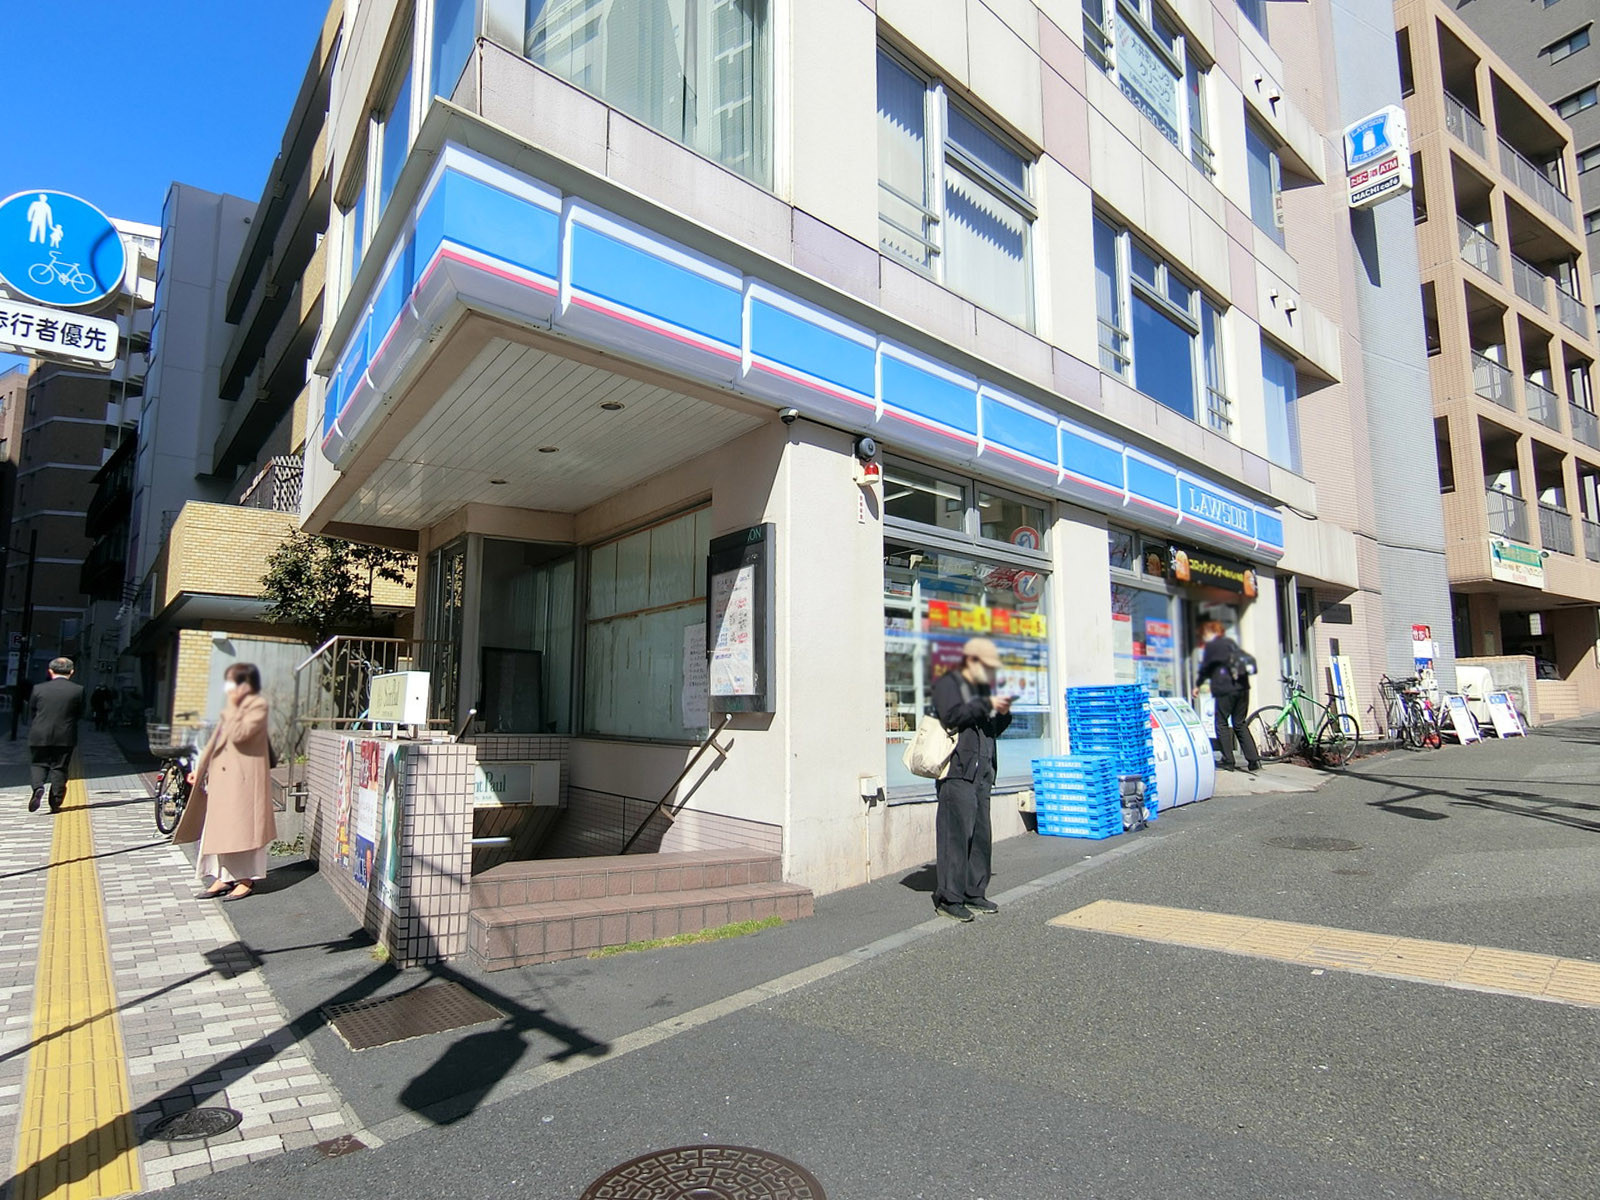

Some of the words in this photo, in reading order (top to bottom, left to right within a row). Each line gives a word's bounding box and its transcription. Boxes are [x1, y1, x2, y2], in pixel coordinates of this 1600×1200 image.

[1380, 158, 1398, 173] ATM
[1353, 186, 1380, 202] MACHI
[1189, 487, 1248, 532] LAWSON
[485, 771, 506, 793] Paul
